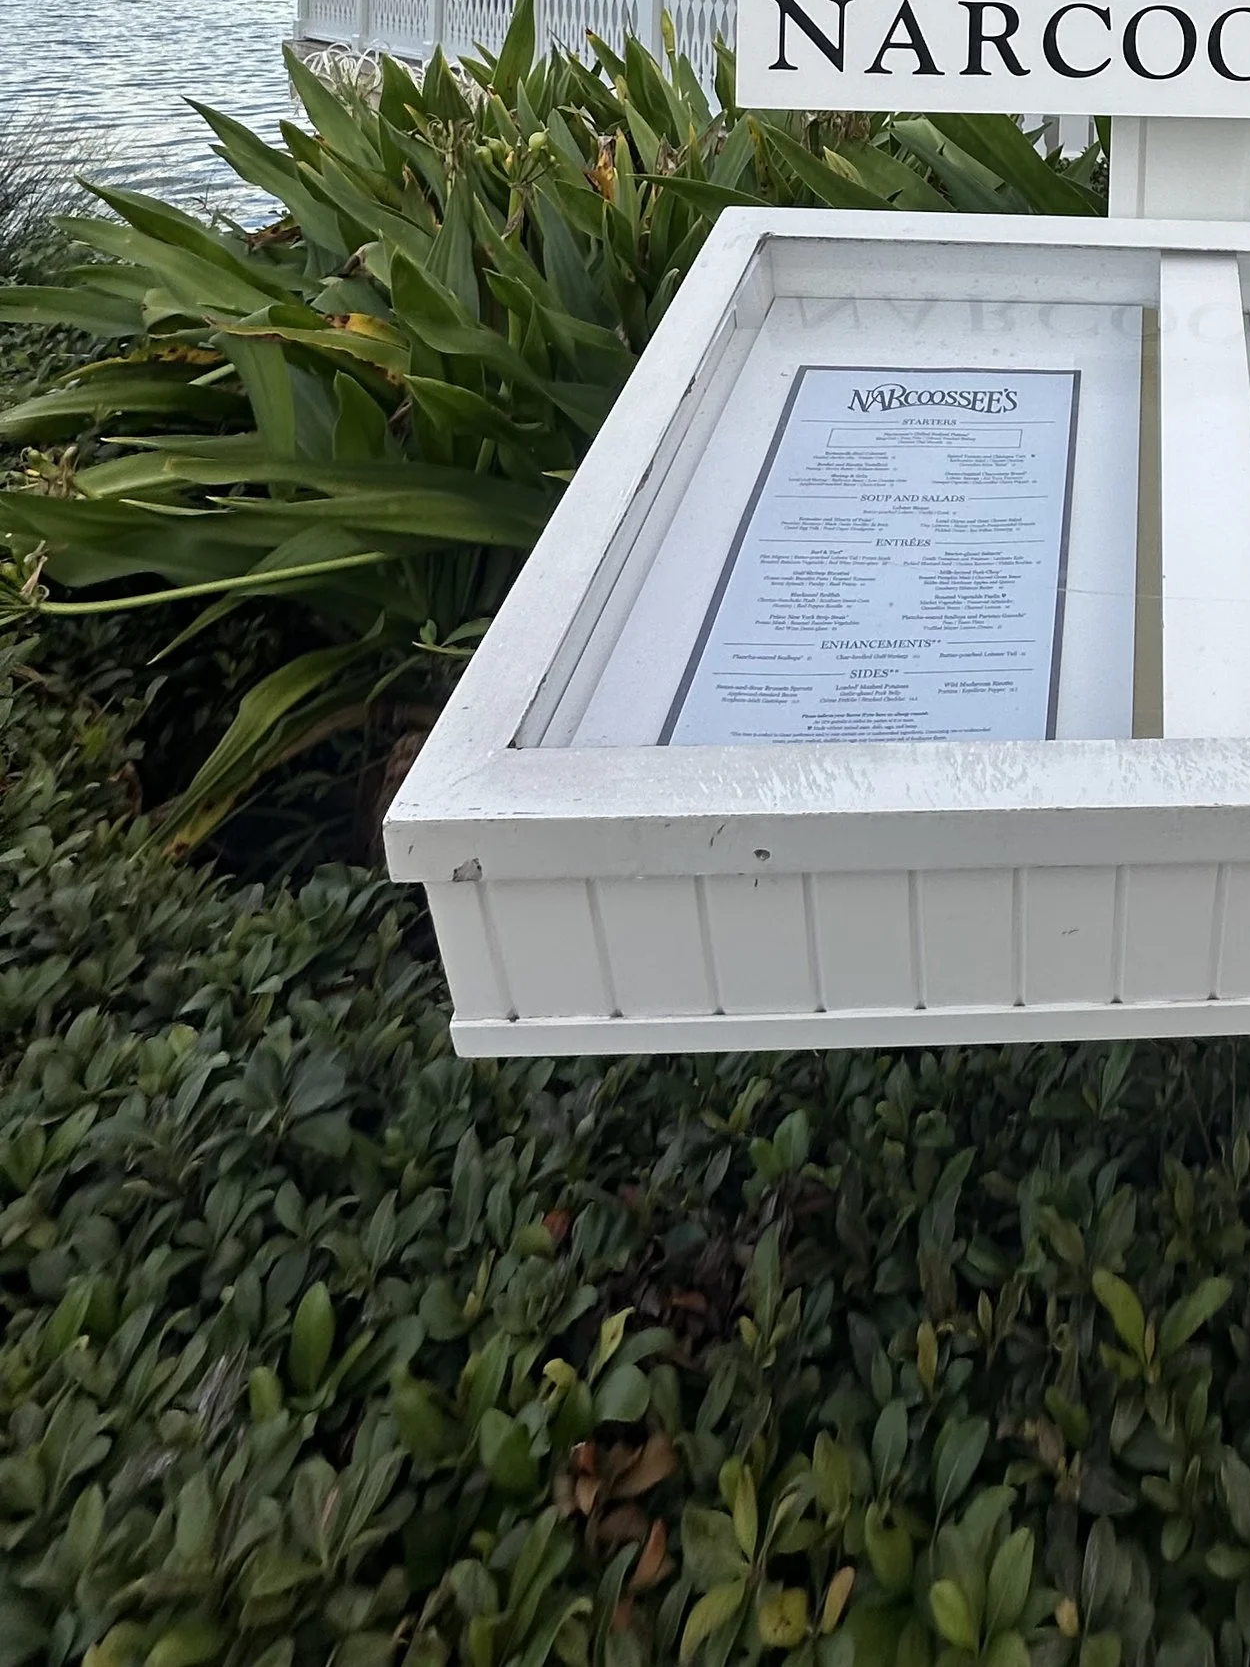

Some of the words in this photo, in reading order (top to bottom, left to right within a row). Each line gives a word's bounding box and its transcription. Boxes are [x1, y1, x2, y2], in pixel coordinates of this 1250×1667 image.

[847, 383, 1018, 414] NARCOOSSEE'S
[902, 418, 957, 427] STARTERS
[860, 494, 892, 502] SOUP
[893, 494, 920, 502] AND
[921, 494, 966, 503] SALADS
[875, 537, 932, 547] ENTRÉES
